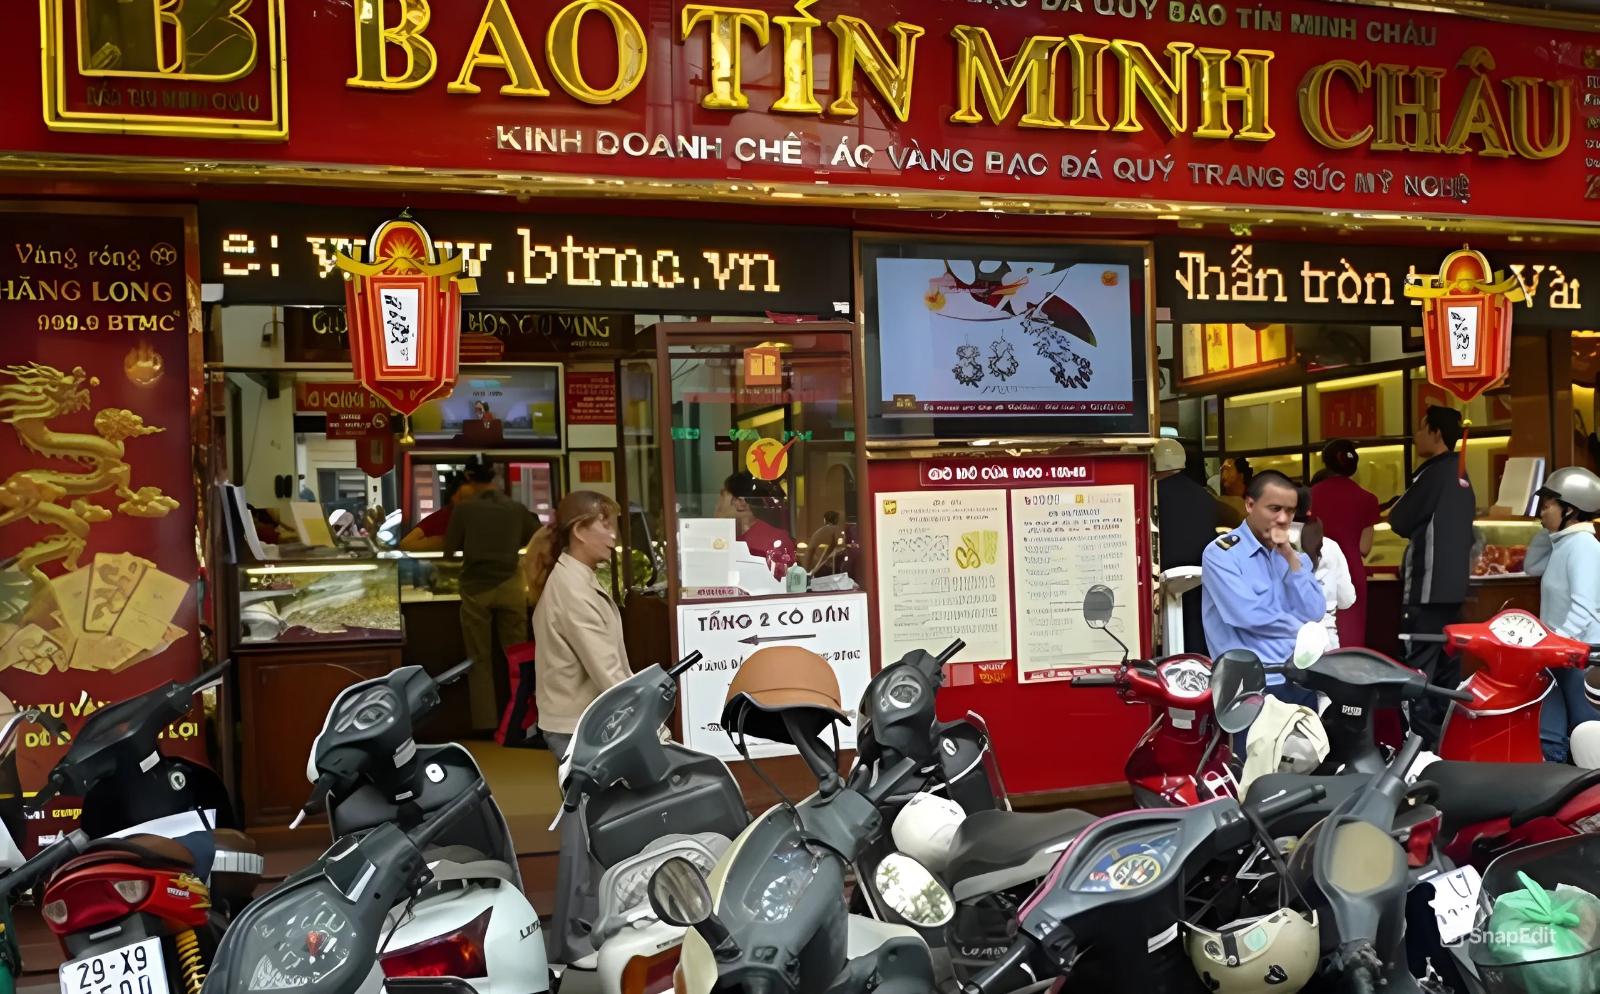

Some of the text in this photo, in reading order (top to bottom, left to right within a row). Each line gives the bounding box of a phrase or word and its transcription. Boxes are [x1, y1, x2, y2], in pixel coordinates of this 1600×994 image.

[1291, 13, 1357, 40] MINH
[950, 24, 1276, 141] MINH
[1298, 46, 1573, 160] CHÂU
[497, 126, 582, 153] KINH
[598, 131, 721, 159] DOANH
[887, 139, 973, 174] VÀNG
[985, 151, 1049, 180] BẠC
[1061, 150, 1102, 180] ĐÁ
[1113, 154, 1175, 183] QUÝ
[1188, 162, 1285, 188] TRANG
[1293, 163, 1345, 192] SỨC
[92, 281, 173, 302] LONG
[1301, 257, 1394, 305] tròn
[759, 612, 770, 627] 2
[77, 946, 147, 989] 29-X9
